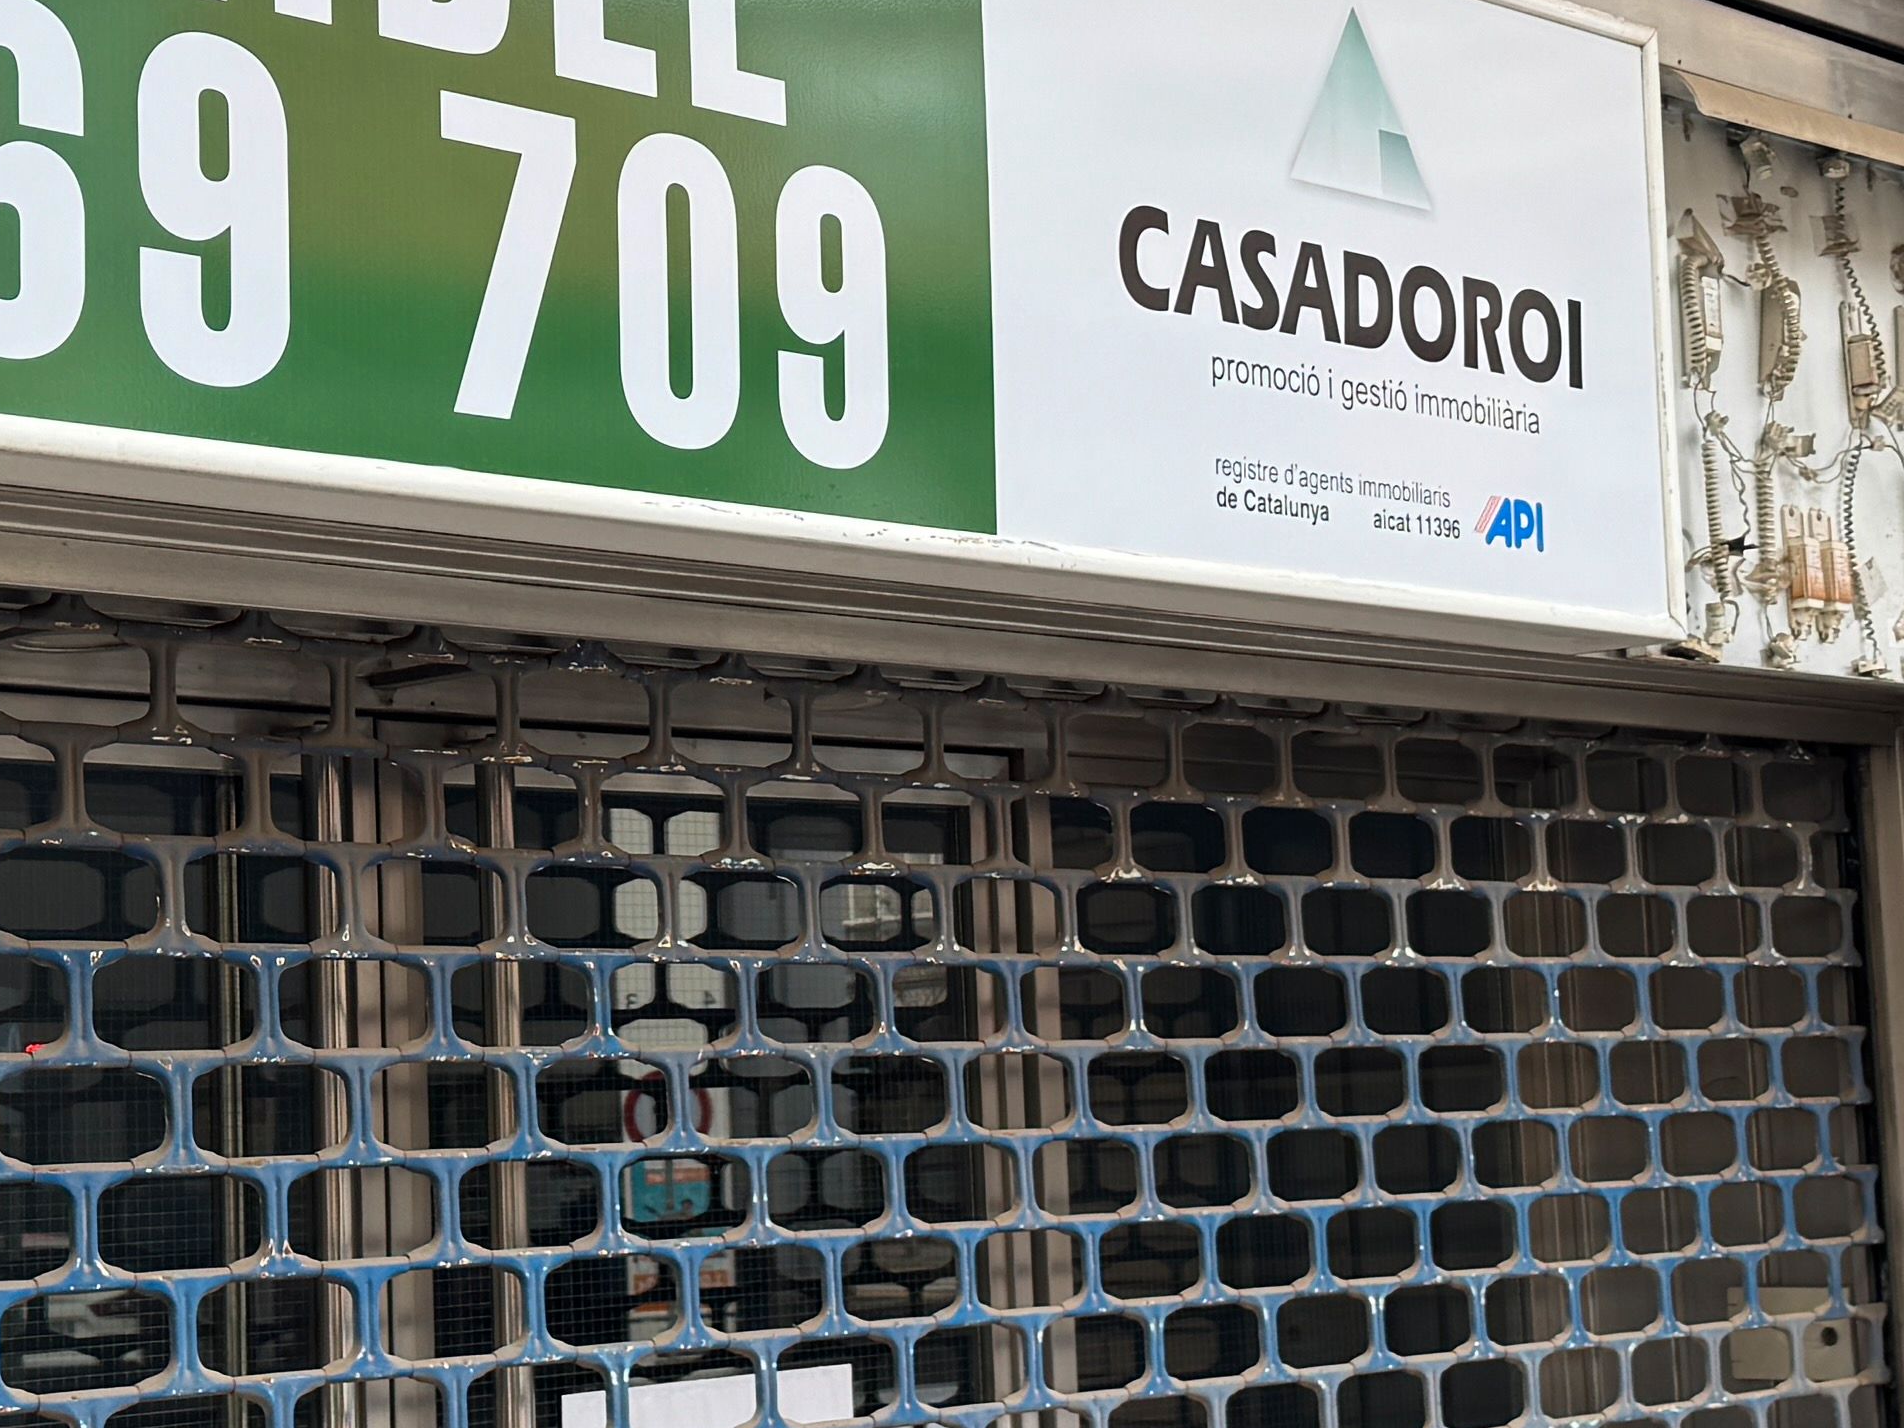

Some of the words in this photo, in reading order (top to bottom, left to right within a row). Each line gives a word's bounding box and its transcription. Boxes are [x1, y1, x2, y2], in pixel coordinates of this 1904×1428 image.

[440, 91, 890, 470] 709
[1118, 205, 1584, 390] CASADOROI
[1211, 356, 1320, 397] promoció
[1328, 369, 1333, 399] i
[1341, 379, 1407, 411] gestió
[1415, 384, 1540, 434] immobiliària
[1215, 456, 1278, 484] registre
[1284, 464, 1353, 495] d'agents
[1358, 474, 1451, 508] immobiliaris
[1216, 486, 1238, 510] de
[1244, 489, 1329, 526] Catalunya
[1373, 509, 1410, 533] aicat
[1416, 514, 1461, 540] 11396
[1485, 497, 1544, 552] API
